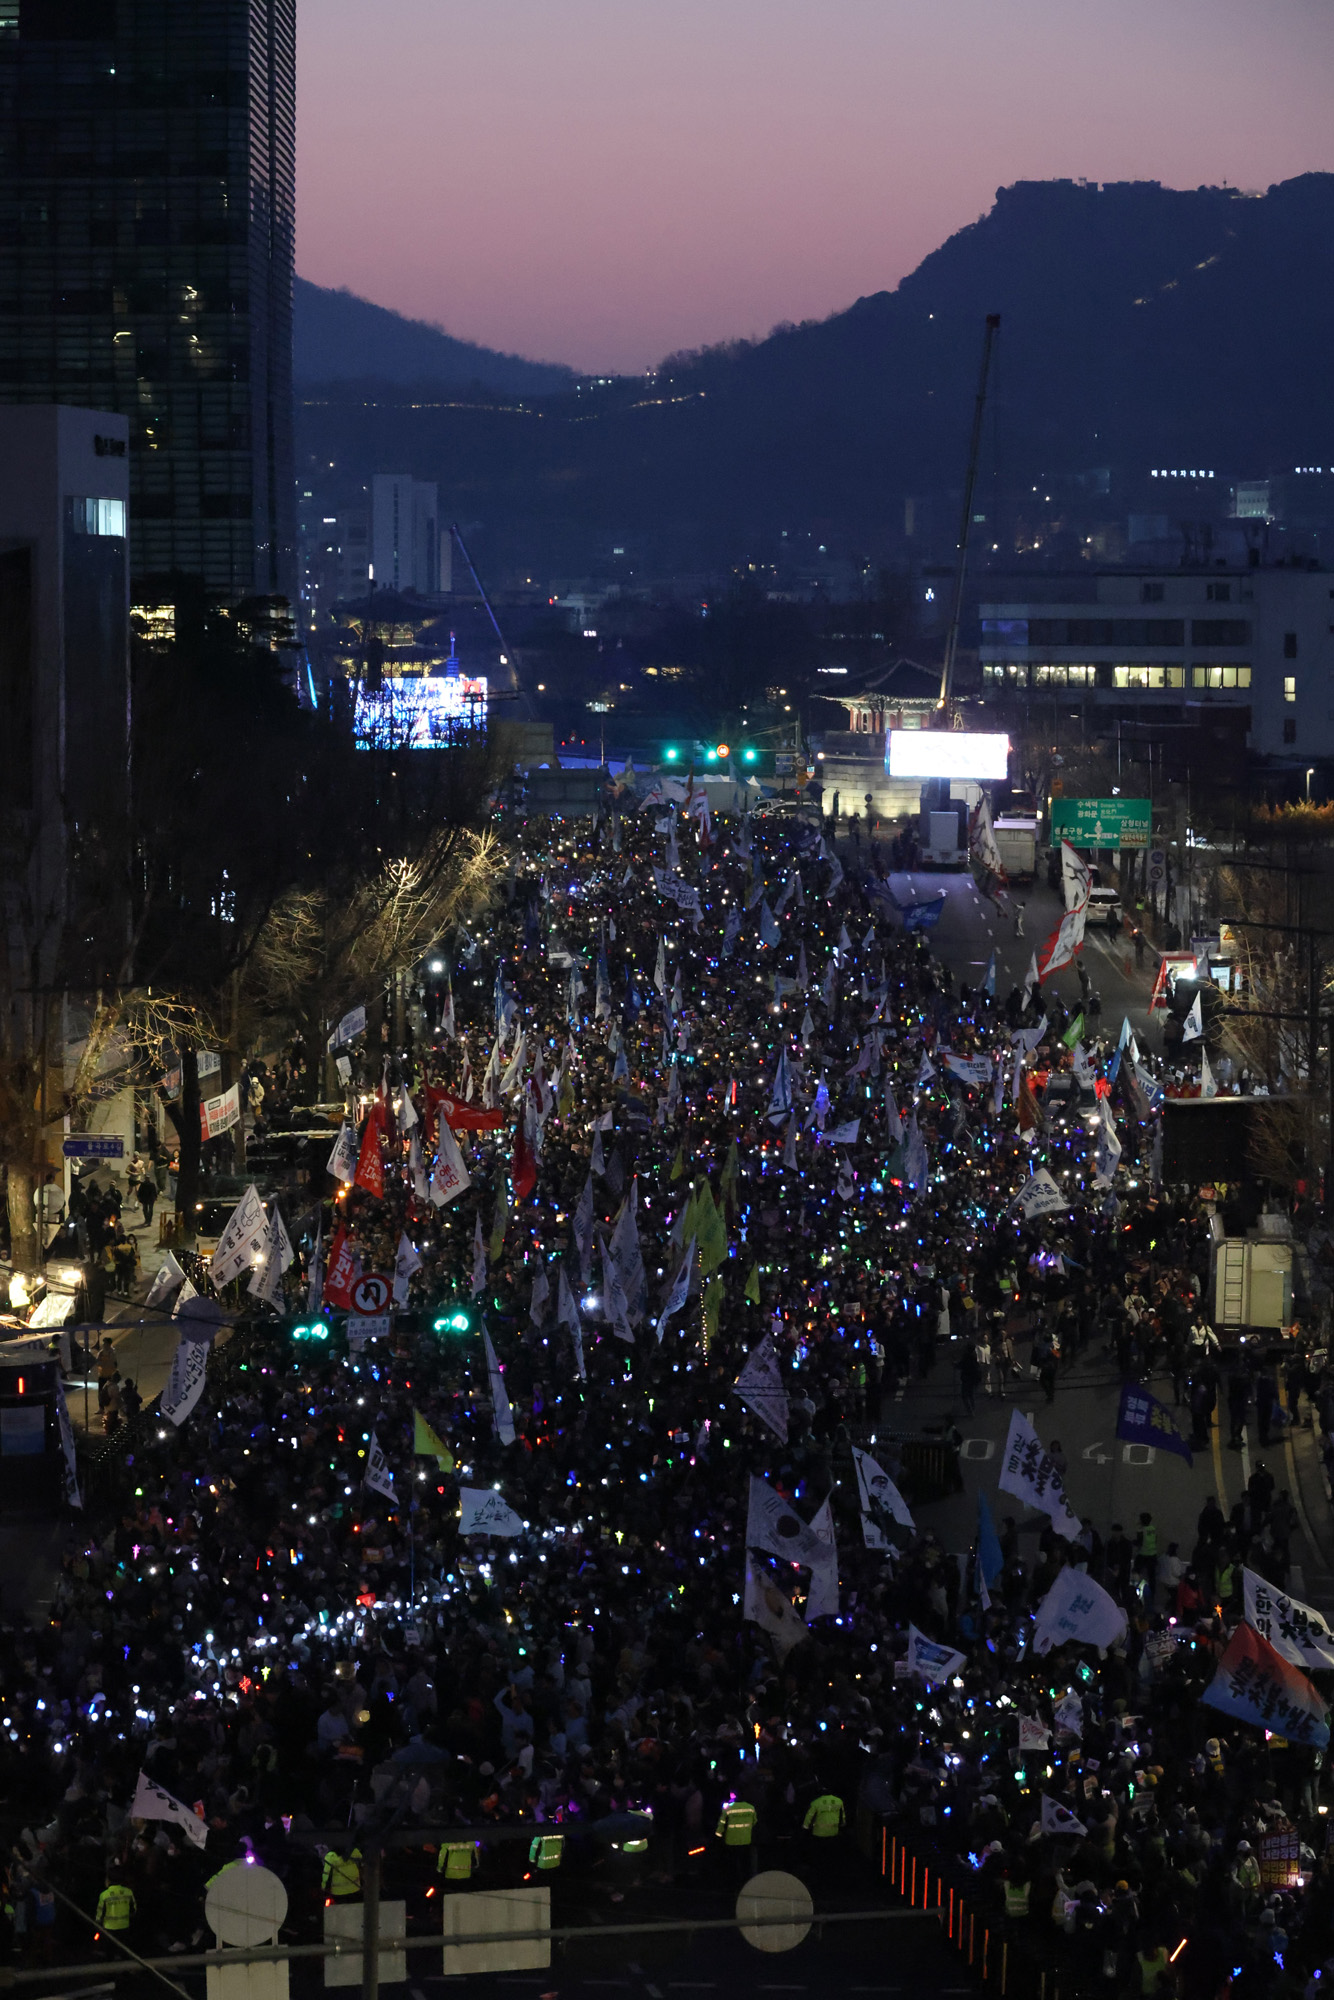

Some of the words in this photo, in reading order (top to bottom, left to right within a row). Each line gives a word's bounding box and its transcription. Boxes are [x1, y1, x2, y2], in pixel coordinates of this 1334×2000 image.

[1151, 469, 1215, 478] 배화여자대학교
[1077, 801, 1098, 809] 수색역
[1077, 810, 1098, 819] 광화문
[1120, 819, 1149, 828] 삼청터널
[1054, 827, 1083, 836] 종로구청
[1081, 1442, 1156, 1465] 40
